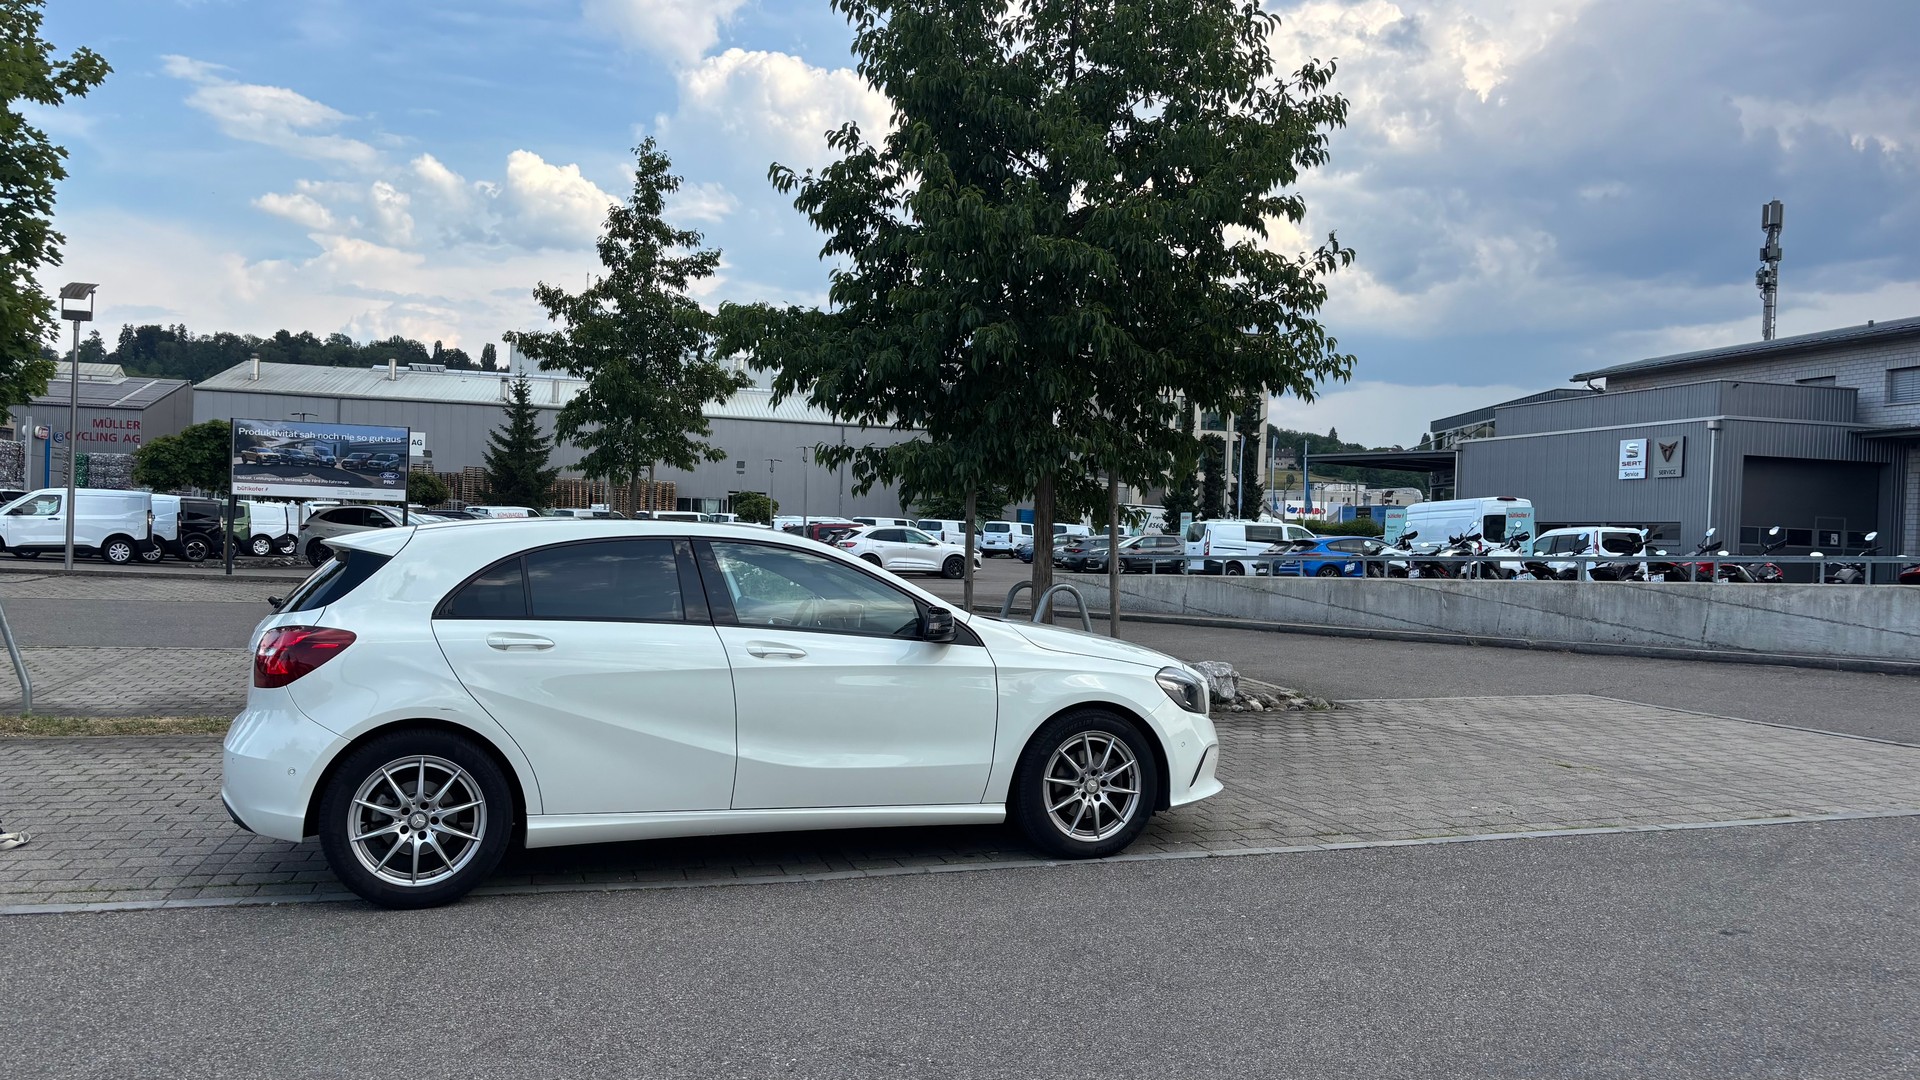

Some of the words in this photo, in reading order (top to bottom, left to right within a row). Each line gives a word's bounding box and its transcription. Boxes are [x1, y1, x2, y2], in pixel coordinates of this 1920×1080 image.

[92, 417, 140, 429] MÜLLER
[123, 434, 140, 443] AG
[238, 427, 298, 438] Produktivität
[299, 431, 316, 439] sah
[317, 432, 339, 440] noch
[341, 433, 355, 441] nie
[369, 436, 384, 444] gut
